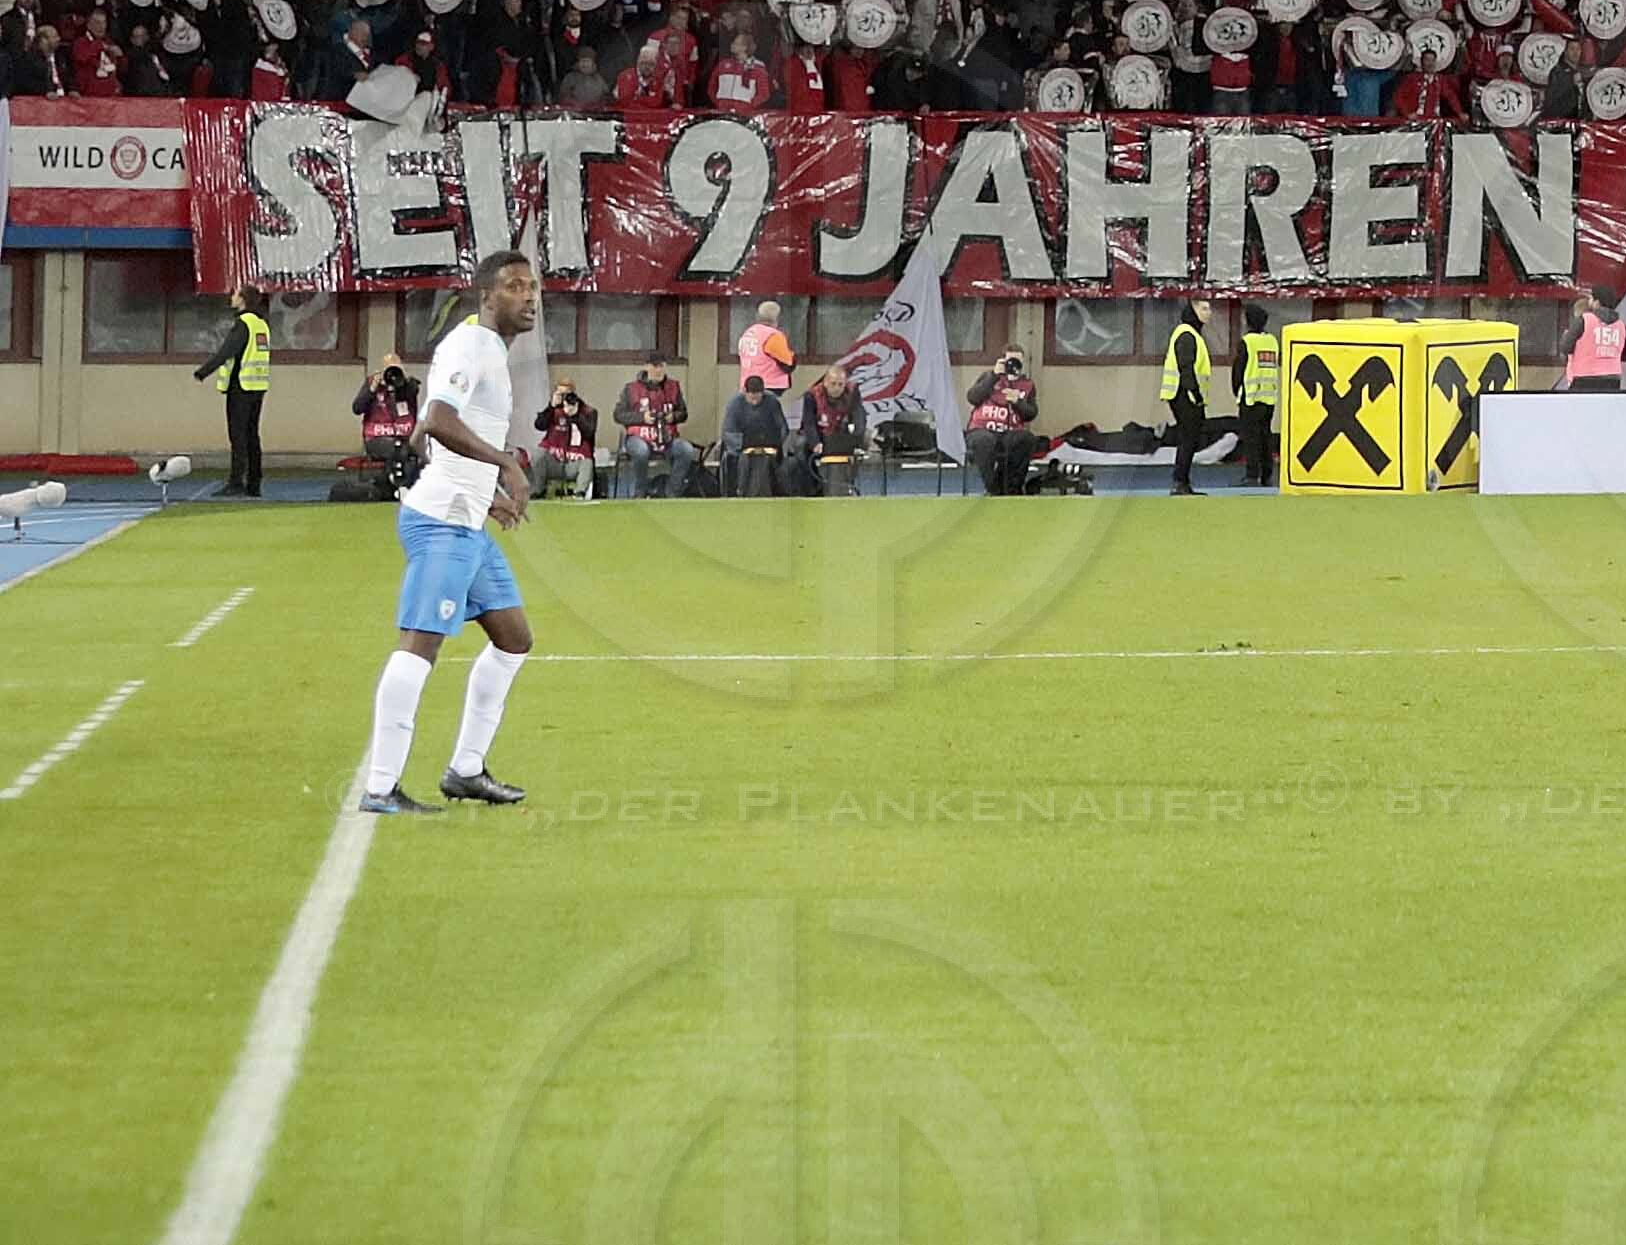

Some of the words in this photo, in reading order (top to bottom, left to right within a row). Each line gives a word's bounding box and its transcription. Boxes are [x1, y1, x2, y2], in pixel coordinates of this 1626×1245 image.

[39, 147, 104, 169] WILD
[250, 102, 624, 277] SEIT
[665, 114, 778, 280] 9
[814, 119, 1580, 285] JAHREN
[1592, 328, 1620, 346] 154
